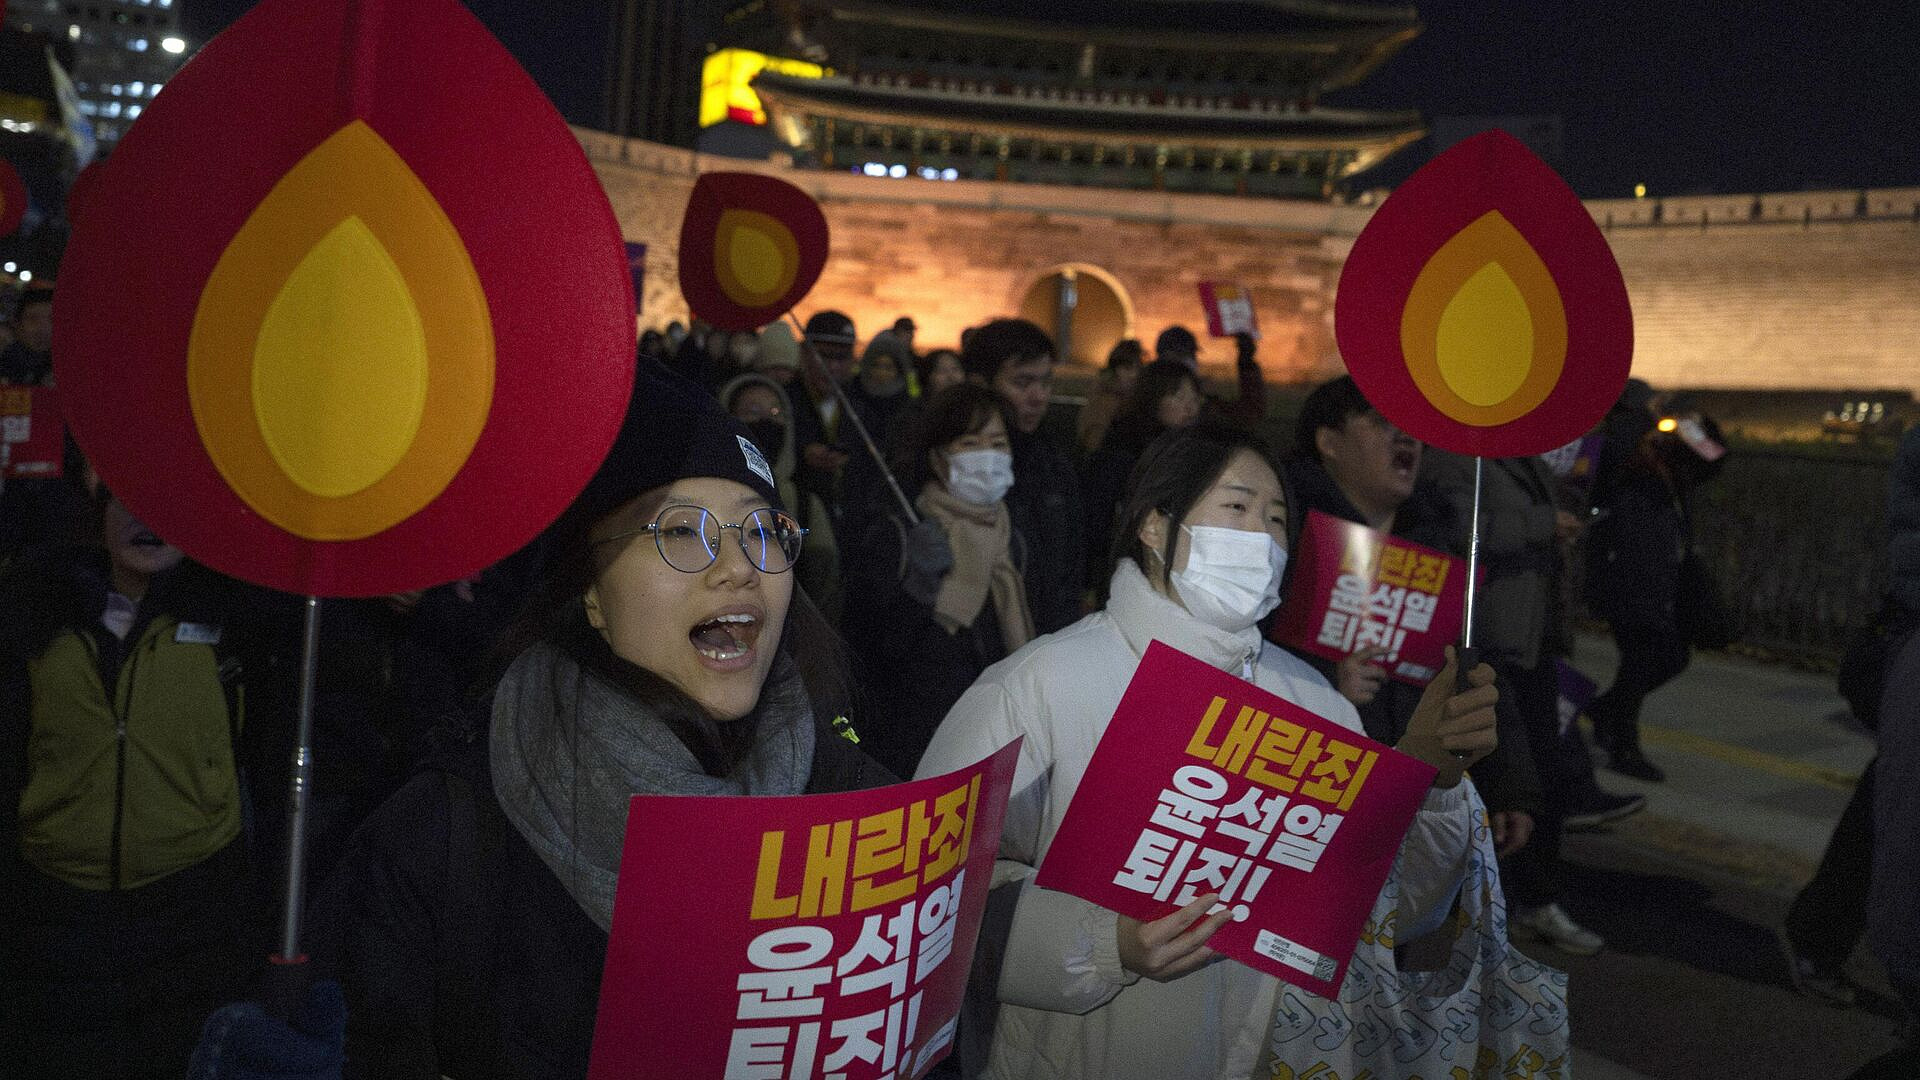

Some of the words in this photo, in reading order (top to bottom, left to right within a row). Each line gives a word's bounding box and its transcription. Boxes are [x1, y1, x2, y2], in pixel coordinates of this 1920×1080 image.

[1329, 574, 1438, 633] 윤석열
[1185, 696, 1379, 812] 내란죄
[750, 773, 982, 920] 내란죄
[1112, 828, 1272, 922] 퇴진!
[1149, 765, 1344, 873] 윤석열
[736, 869, 966, 1020] 윤석열
